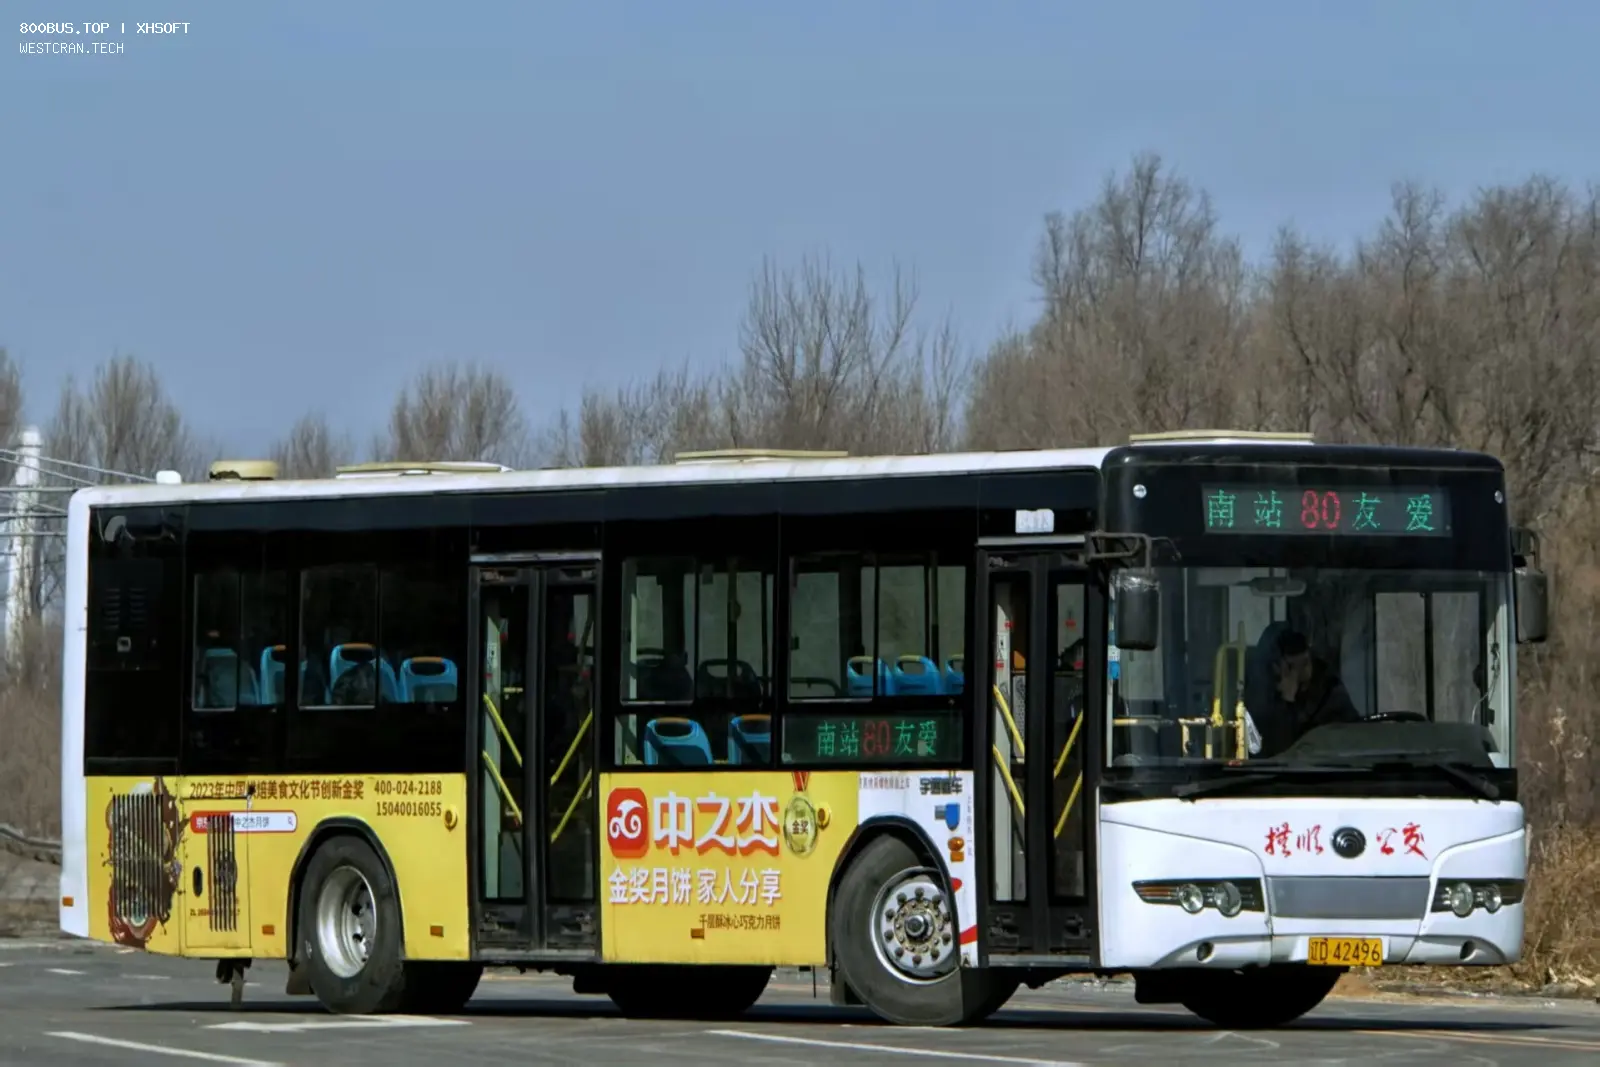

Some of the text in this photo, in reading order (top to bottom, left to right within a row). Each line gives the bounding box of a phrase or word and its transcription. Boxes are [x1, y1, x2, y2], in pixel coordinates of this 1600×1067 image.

[374, 781, 442, 795] 400-024-2188
[376, 801, 442, 816] 15040016055
[653, 790, 780, 855] 中之杰
[792, 820, 809, 835] 金奖
[608, 865, 783, 905] 金奖月饼 家人分享
